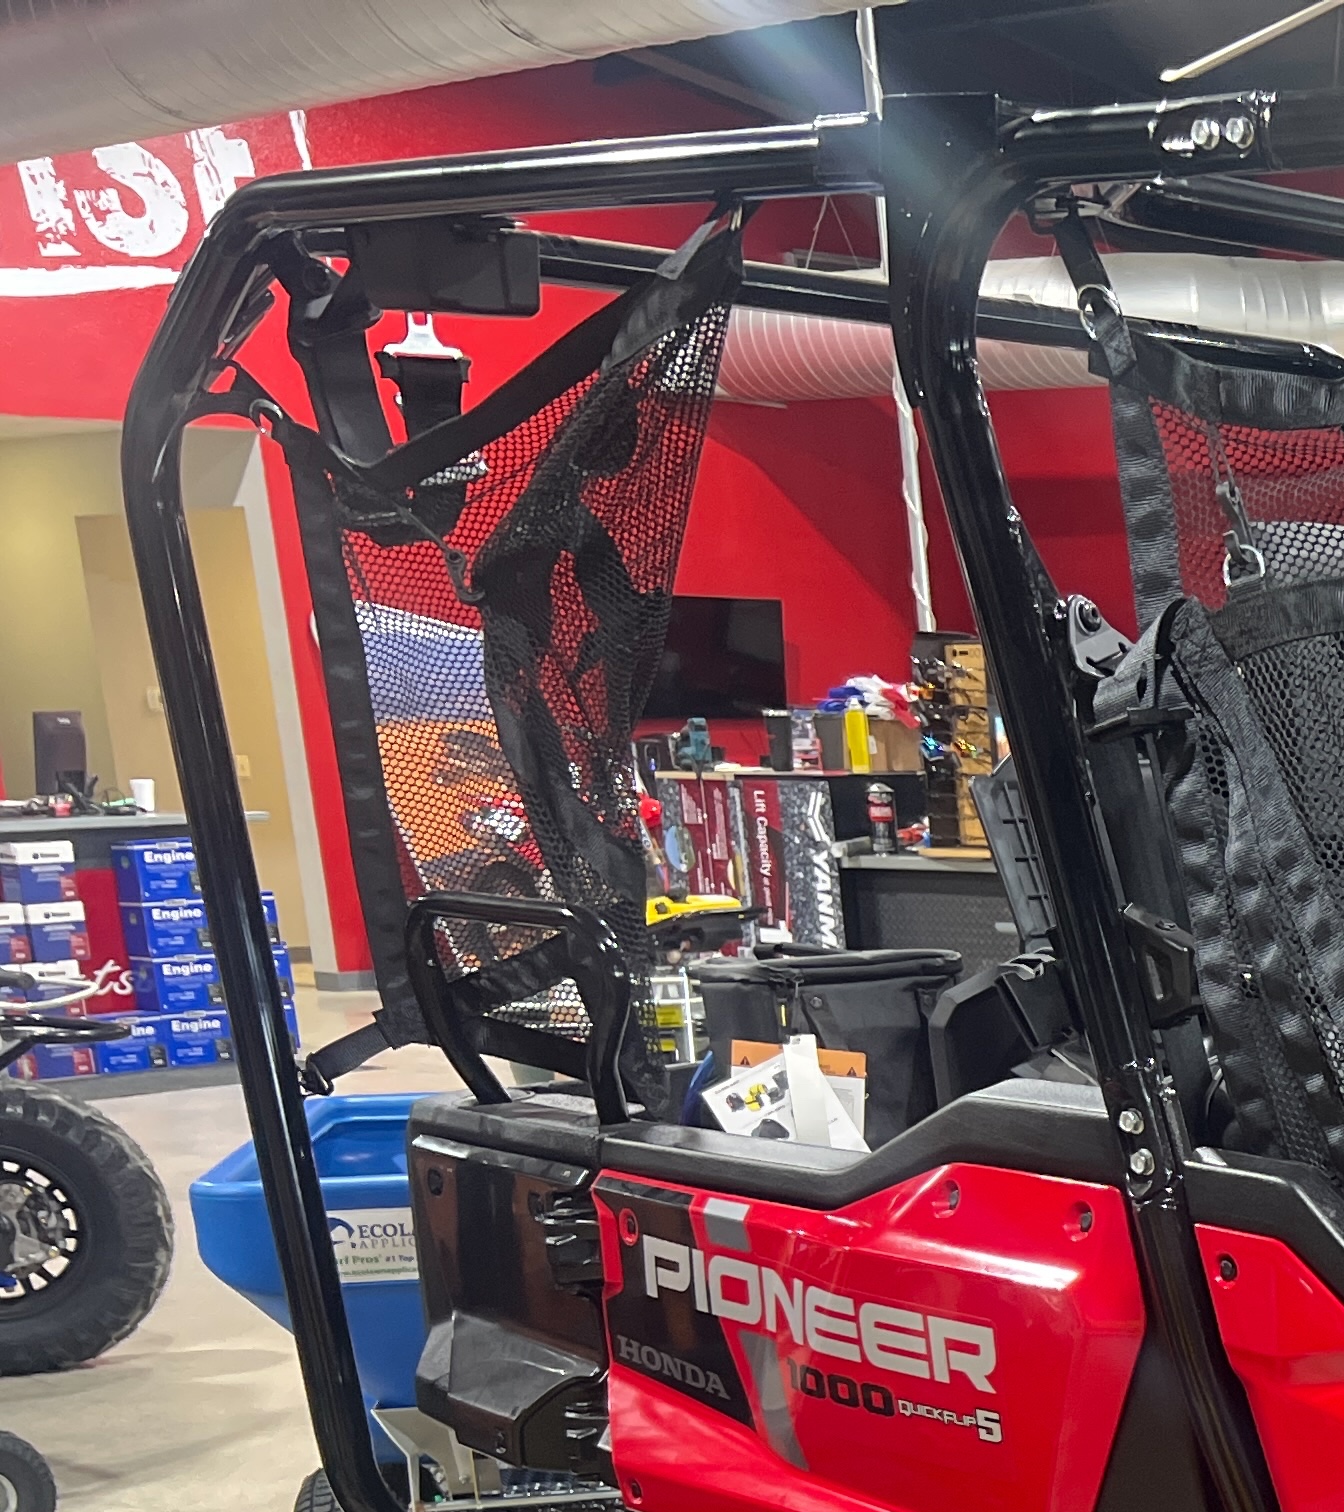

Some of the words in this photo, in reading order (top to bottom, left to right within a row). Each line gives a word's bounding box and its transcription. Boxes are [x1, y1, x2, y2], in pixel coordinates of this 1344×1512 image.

[753, 790, 767, 812] Lift
[757, 816, 773, 877] Capacity
[144, 850, 196, 864] Engine
[152, 907, 204, 921] Engine
[162, 962, 213, 976] Engine
[131, 1025, 156, 1037] ine
[171, 1019, 221, 1033] Engine
[642, 1234, 997, 1394] PIONEER
[617, 1334, 731, 1400] HONDA
[786, 1357, 896, 1417] 1000
